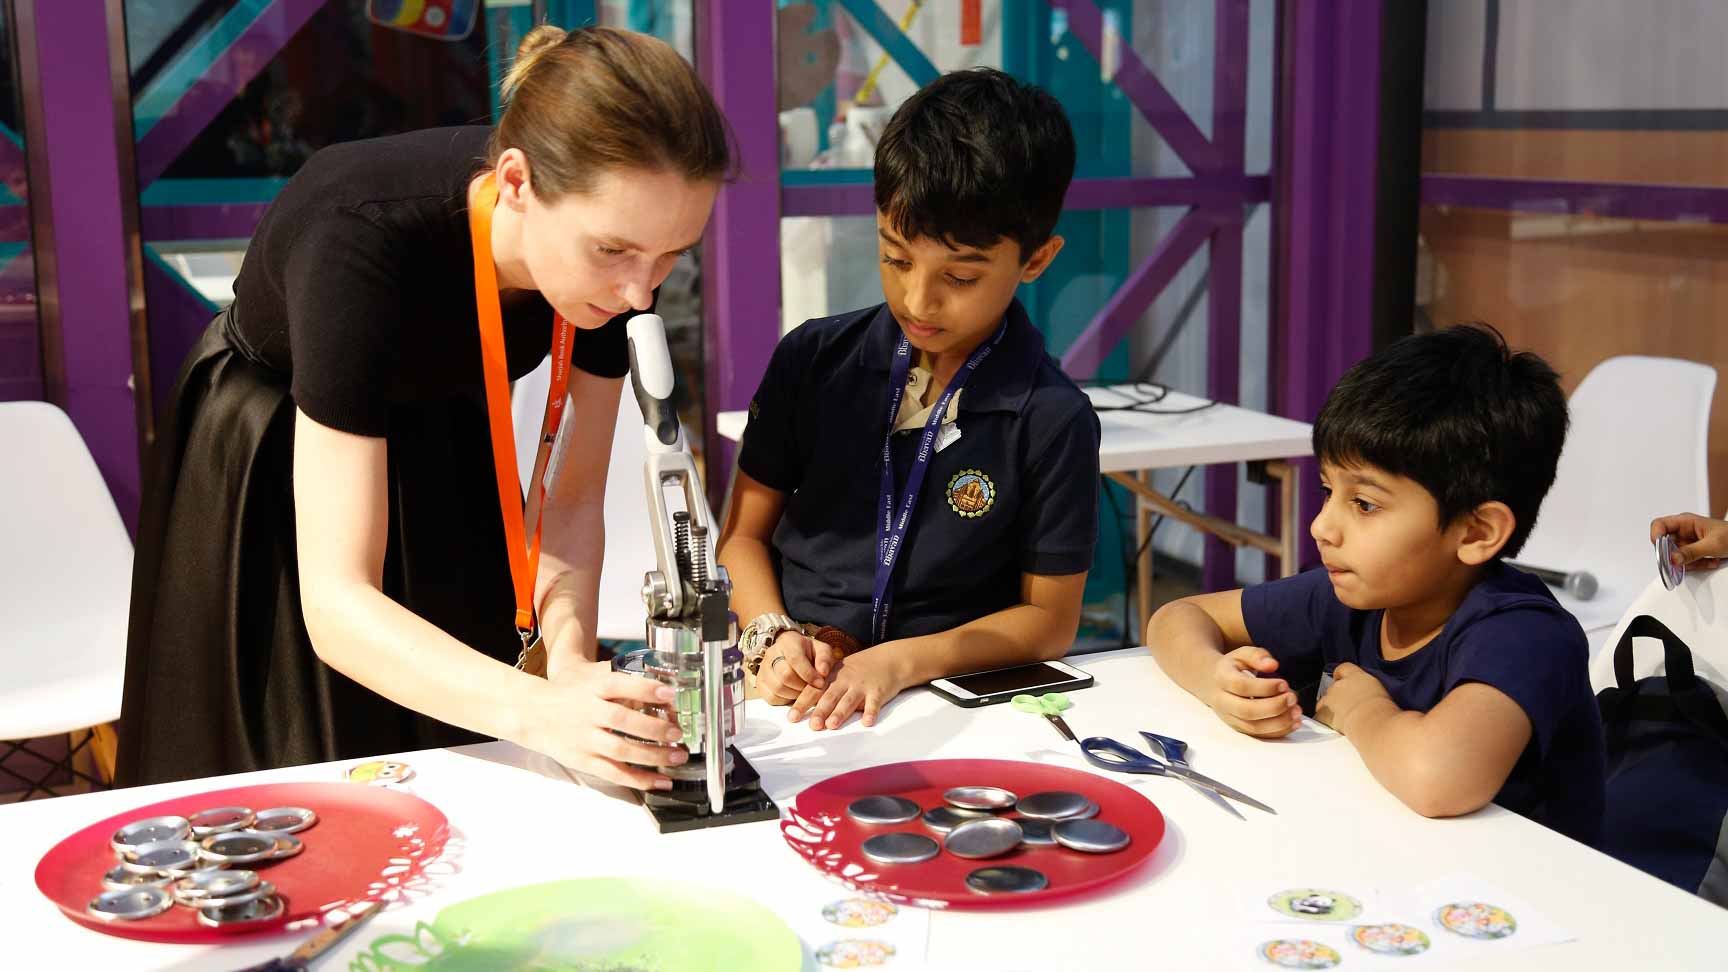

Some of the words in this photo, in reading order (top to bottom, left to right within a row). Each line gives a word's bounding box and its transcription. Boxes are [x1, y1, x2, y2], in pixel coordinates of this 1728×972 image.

[931, 405, 943, 426] Middle
[941, 392, 951, 406] East
[918, 431, 934, 462] Bhavan
[898, 509, 908, 530] Middle
[905, 494, 914, 508] East
[884, 534, 900, 566] Bhavan
